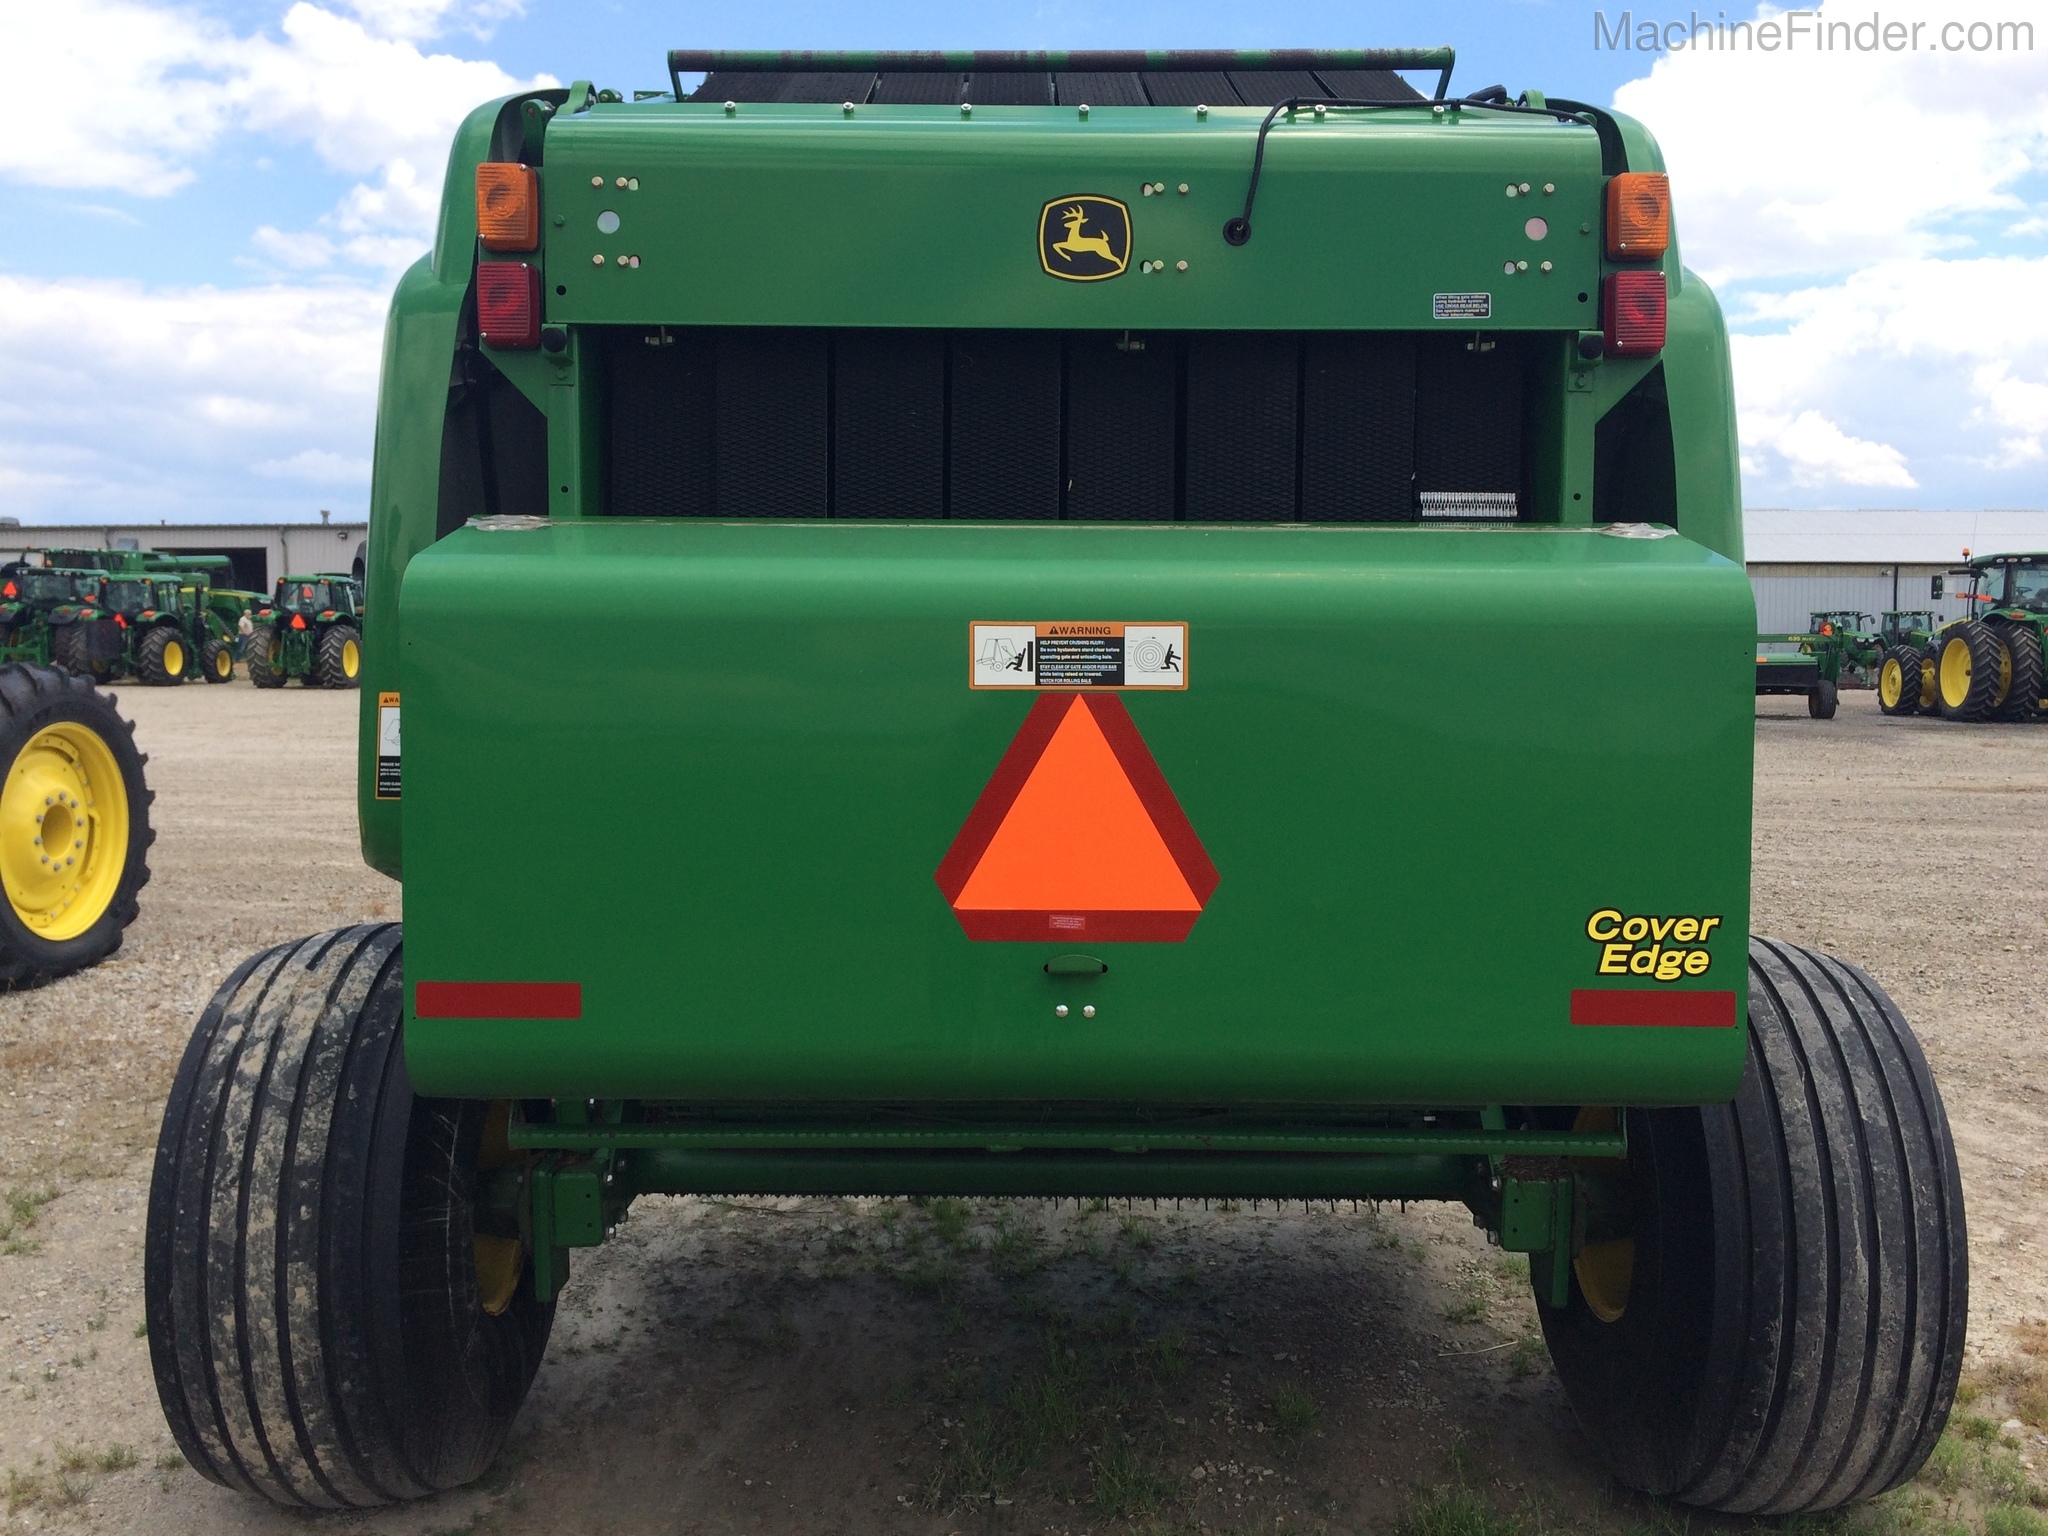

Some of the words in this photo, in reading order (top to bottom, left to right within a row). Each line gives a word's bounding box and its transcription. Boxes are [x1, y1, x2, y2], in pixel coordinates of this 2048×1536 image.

[1059, 626, 1111, 635] WARNING
[1587, 908, 1721, 942] Cover
[1598, 943, 1711, 981] Edge
